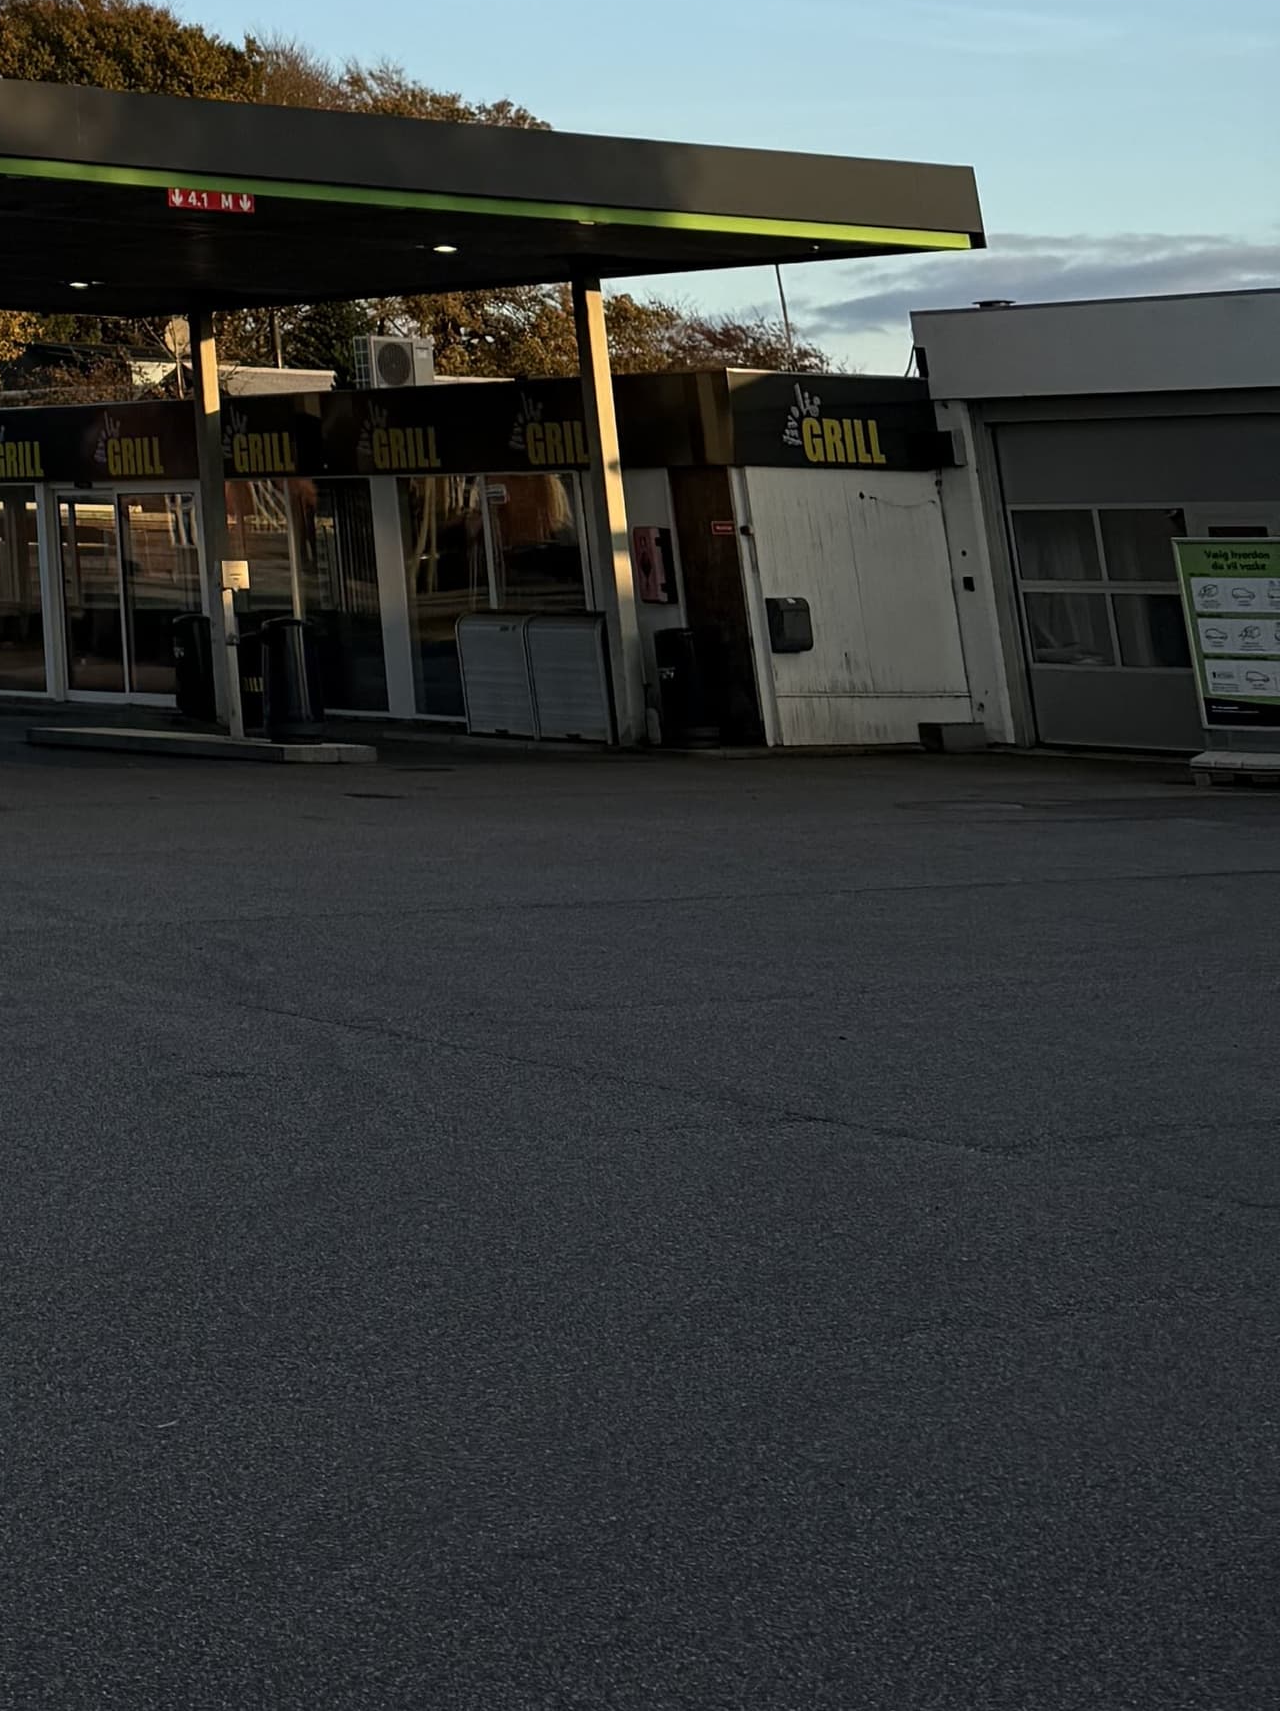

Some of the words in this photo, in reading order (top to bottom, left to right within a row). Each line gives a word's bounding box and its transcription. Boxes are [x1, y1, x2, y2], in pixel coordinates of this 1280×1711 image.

[107, 436, 165, 476] GRILL
[232, 431, 297, 474] GRILL
[371, 425, 442, 469] GRILL
[526, 420, 590, 466] GRIL
[801, 416, 887, 465] GRILL
